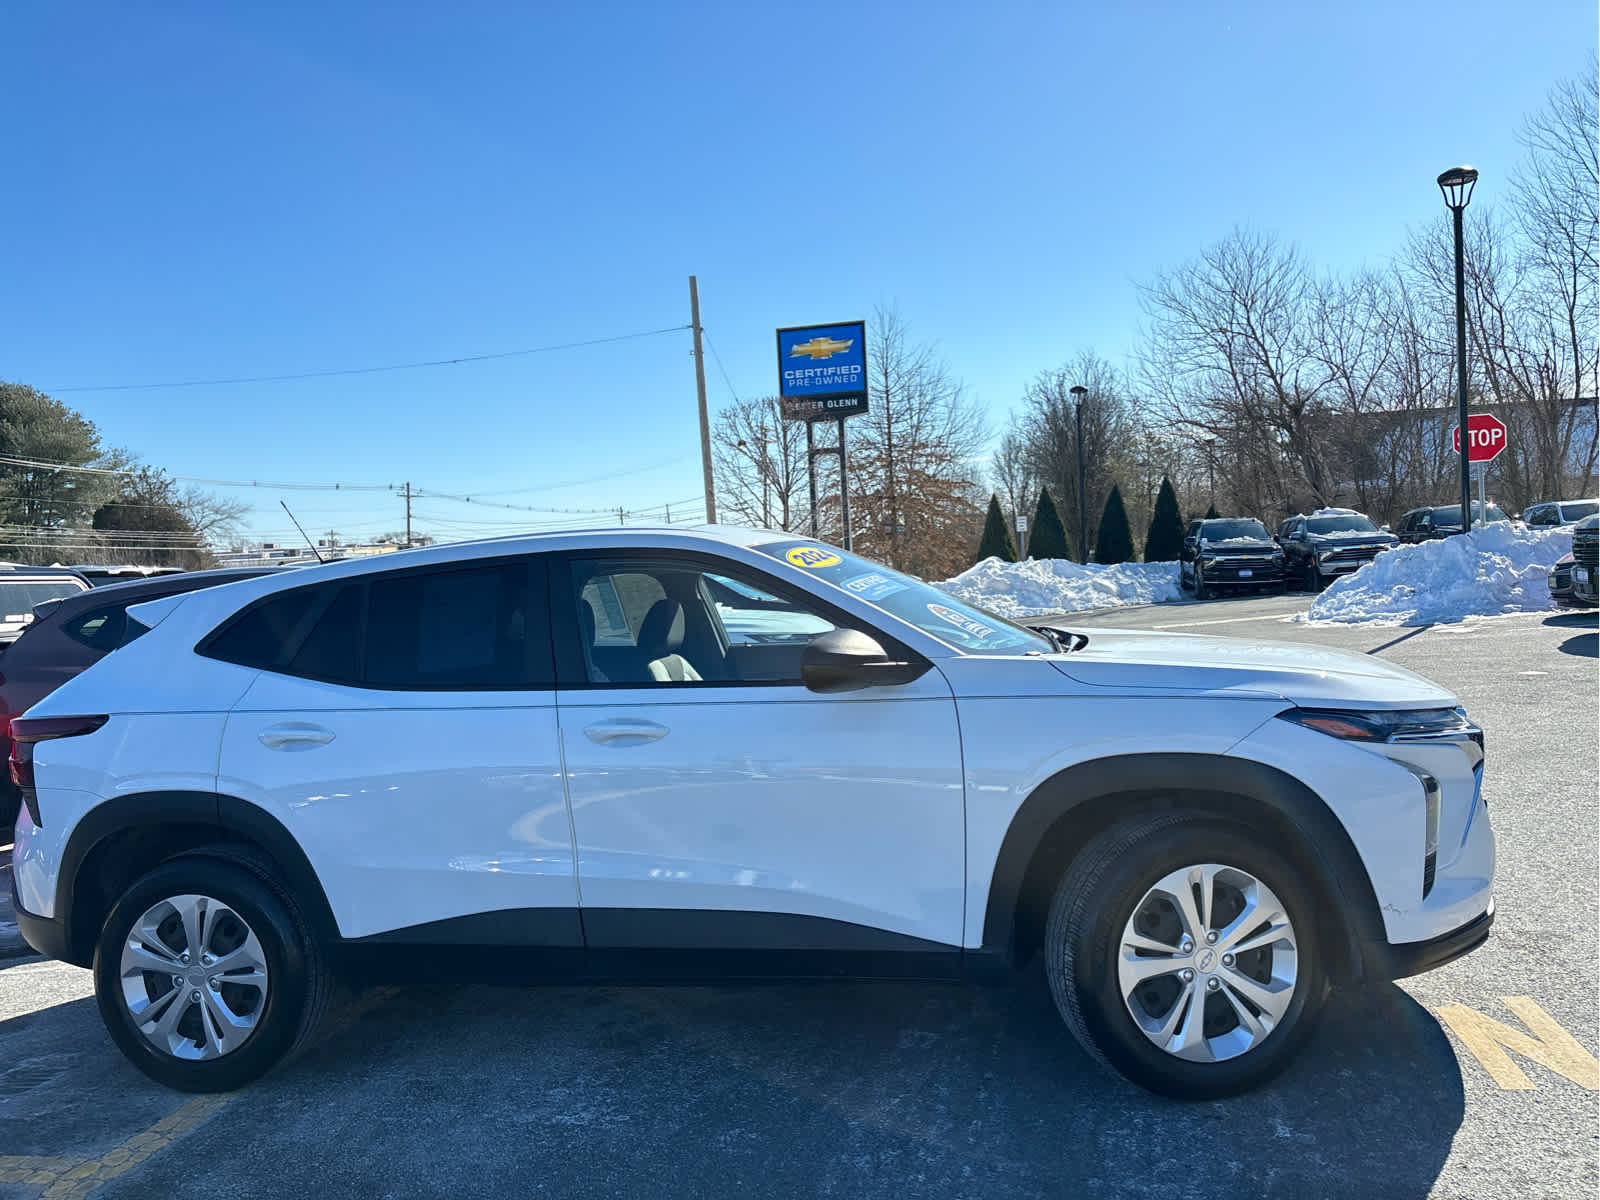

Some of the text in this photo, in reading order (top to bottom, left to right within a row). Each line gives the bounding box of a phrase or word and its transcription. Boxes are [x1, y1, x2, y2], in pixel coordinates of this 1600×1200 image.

[784, 365, 861, 379] CERTIFIED
[788, 374, 857, 387] PRE-OWNED
[827, 398, 858, 408] GLENN
[1457, 428, 1503, 447] TOP
